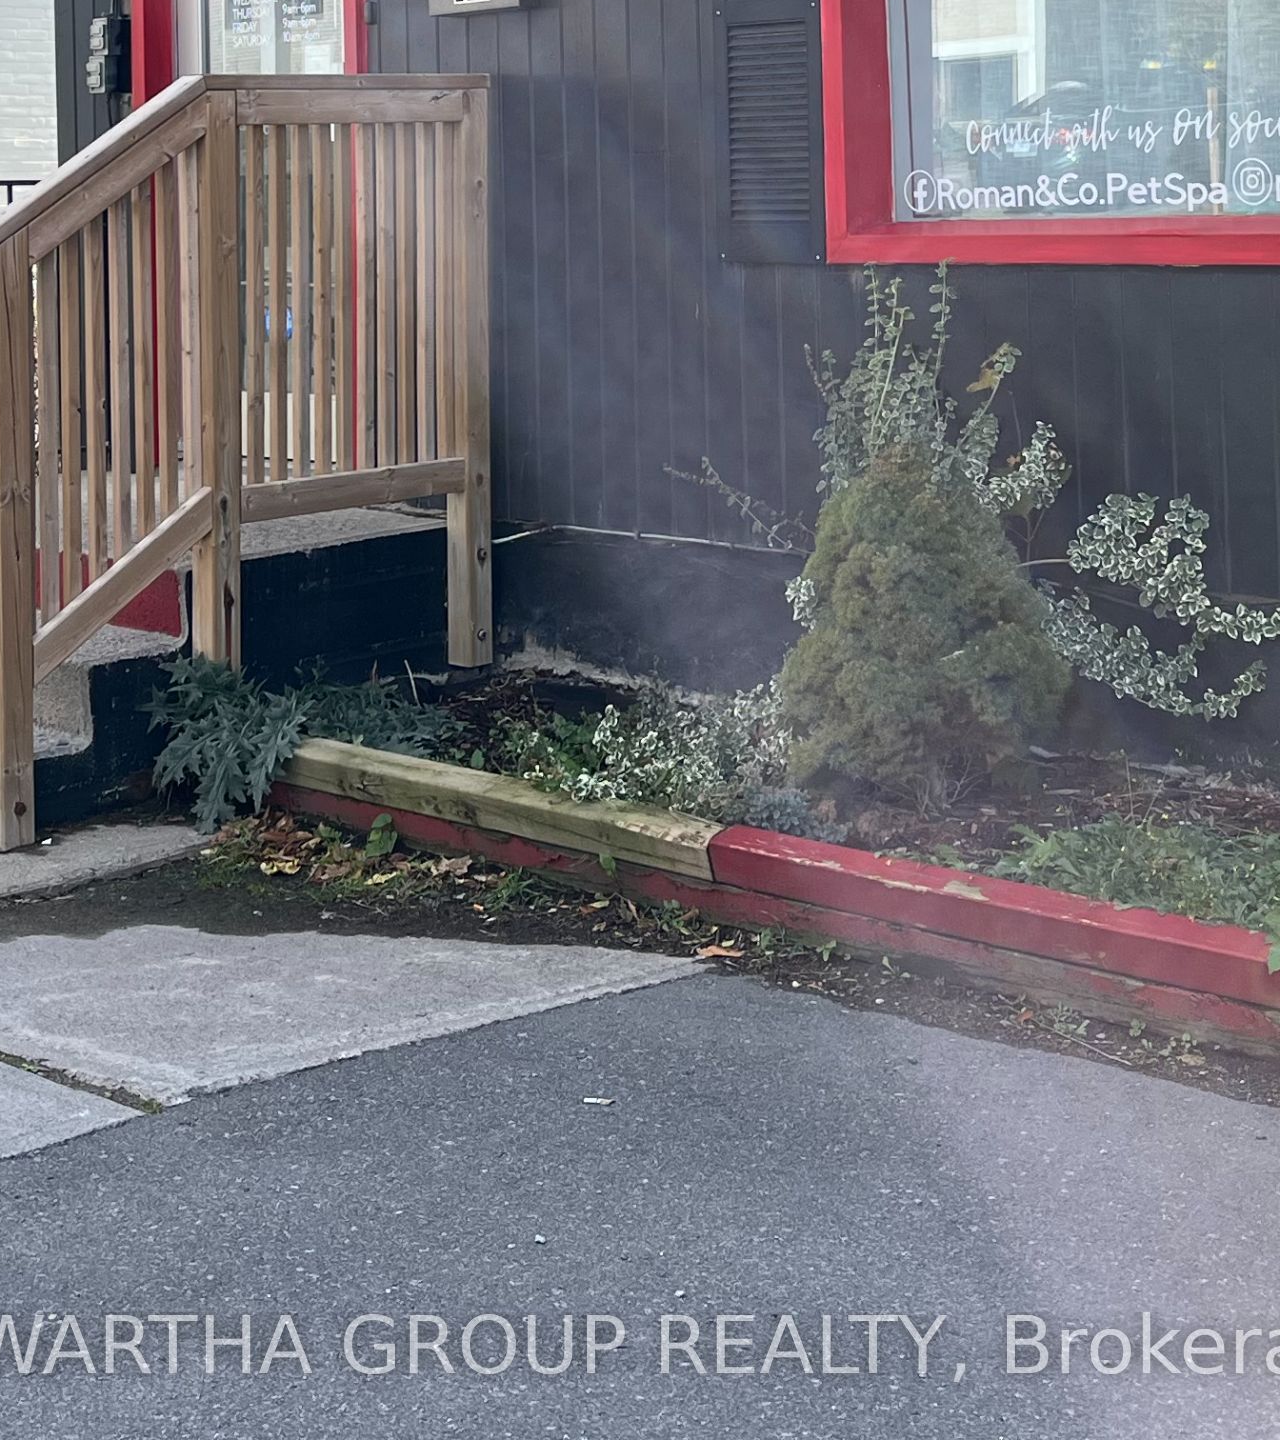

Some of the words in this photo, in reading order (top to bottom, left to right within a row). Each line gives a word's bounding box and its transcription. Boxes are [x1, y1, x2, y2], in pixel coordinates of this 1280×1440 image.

[232, 6, 270, 20] THURSDAY
[282, 1, 317, 15] 9am-6pm
[232, 22, 257, 33] FRIDAY
[233, 33, 273, 48] SATURDAY
[966, 107, 1058, 155] Connect
[1058, 105, 1119, 153] with
[1127, 120, 1163, 153] us
[1173, 108, 1220, 145] on
[936, 172, 1228, 212] Roman&Co.PetSpa
